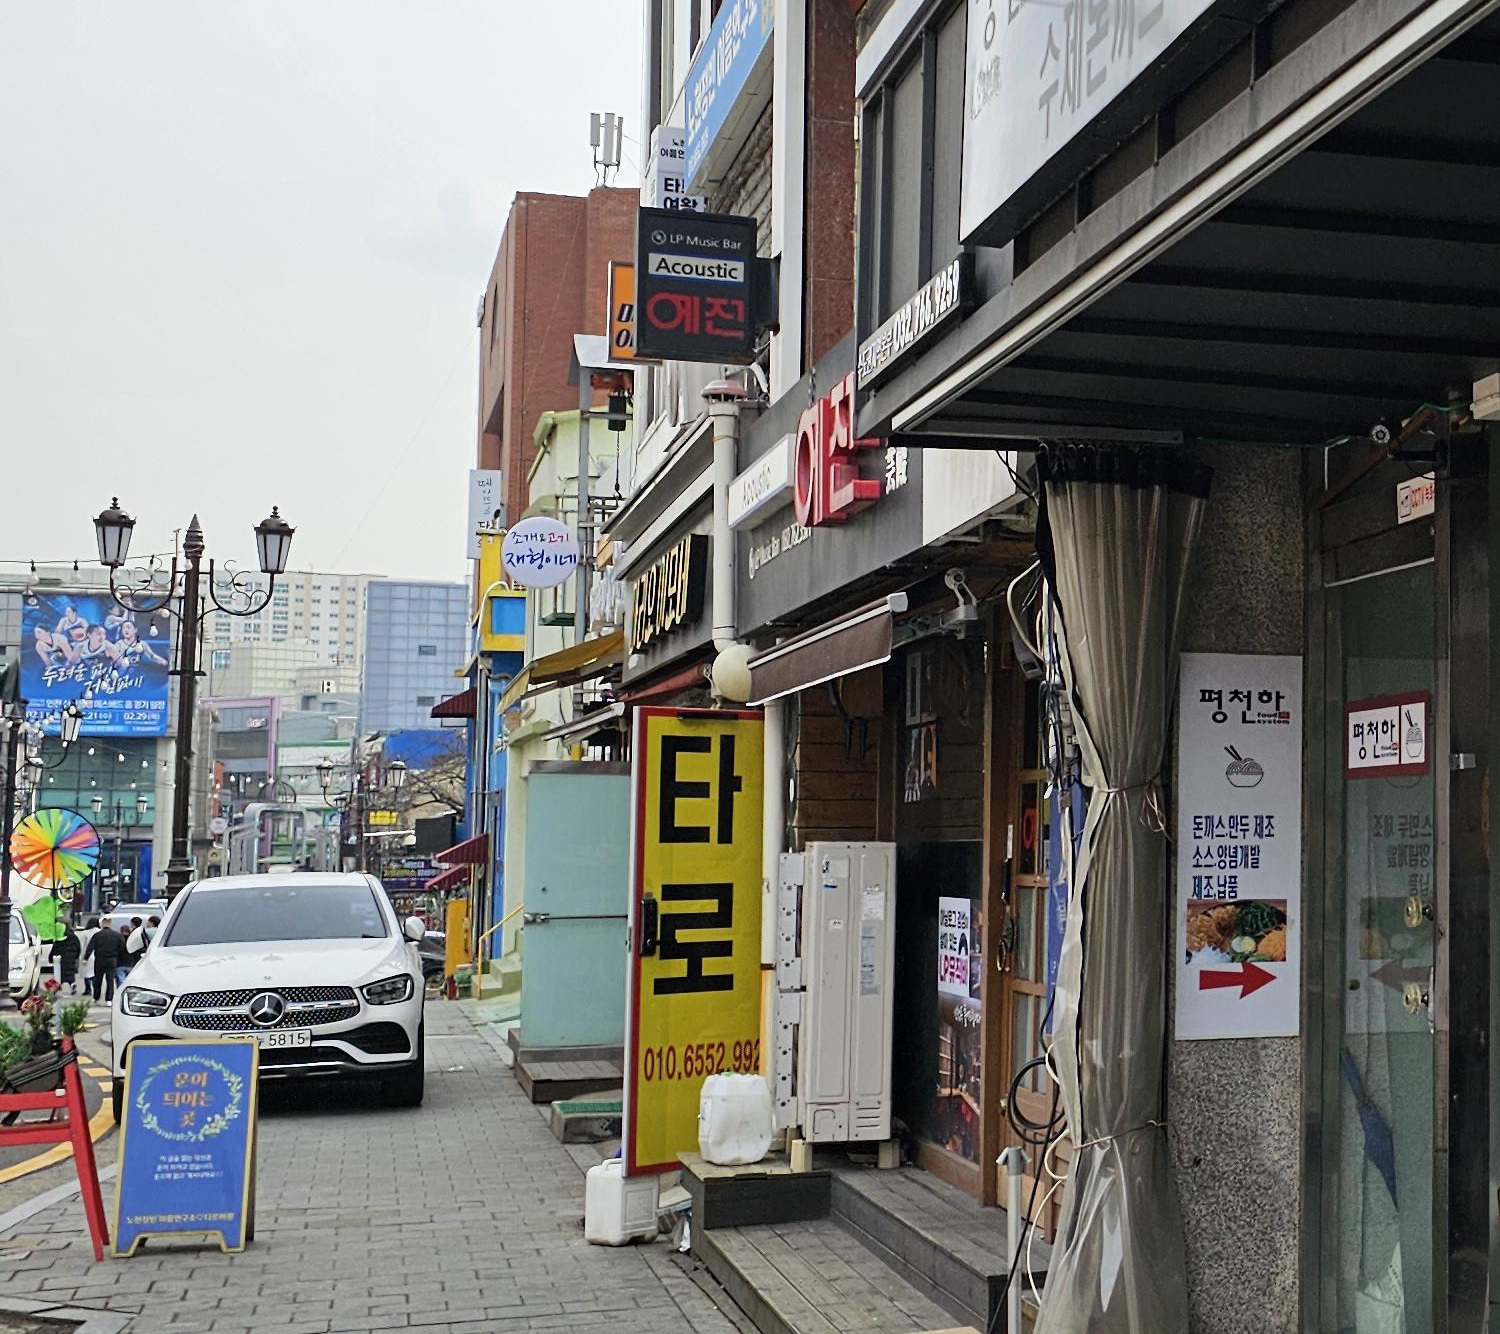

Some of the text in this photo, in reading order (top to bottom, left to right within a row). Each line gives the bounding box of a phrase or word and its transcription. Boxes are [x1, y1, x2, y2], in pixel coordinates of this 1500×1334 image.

[669, 234, 742, 249] LP Music Bar
[655, 257, 738, 280] Acoustic
[646, 291, 745, 339] 예전
[511, 531, 569, 545] 조개&고기
[505, 548, 577, 570] 재형이네
[1199, 688, 1285, 725] 평천하
[1353, 718, 1396, 760] 평천하
[1252, 814, 1275, 840] 제조
[653, 733, 742, 995] 타로
[268, 1032, 305, 1047] 5815
